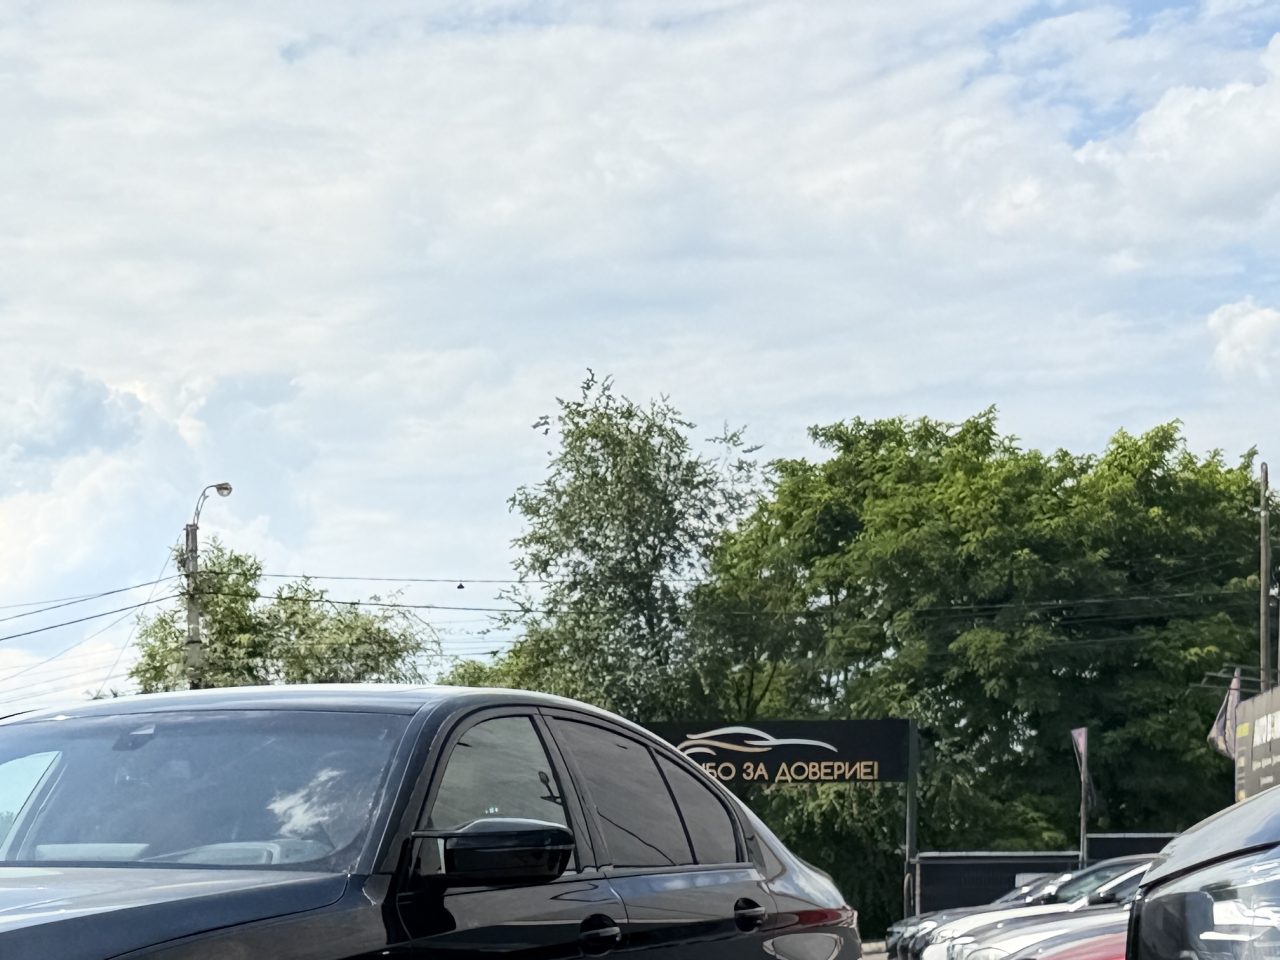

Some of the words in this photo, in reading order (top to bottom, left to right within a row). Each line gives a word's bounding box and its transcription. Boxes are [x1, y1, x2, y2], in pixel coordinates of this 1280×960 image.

[701, 762, 736, 780] БО
[742, 761, 768, 780] ЗА
[774, 760, 878, 783] ДОВЕРИЕ!
